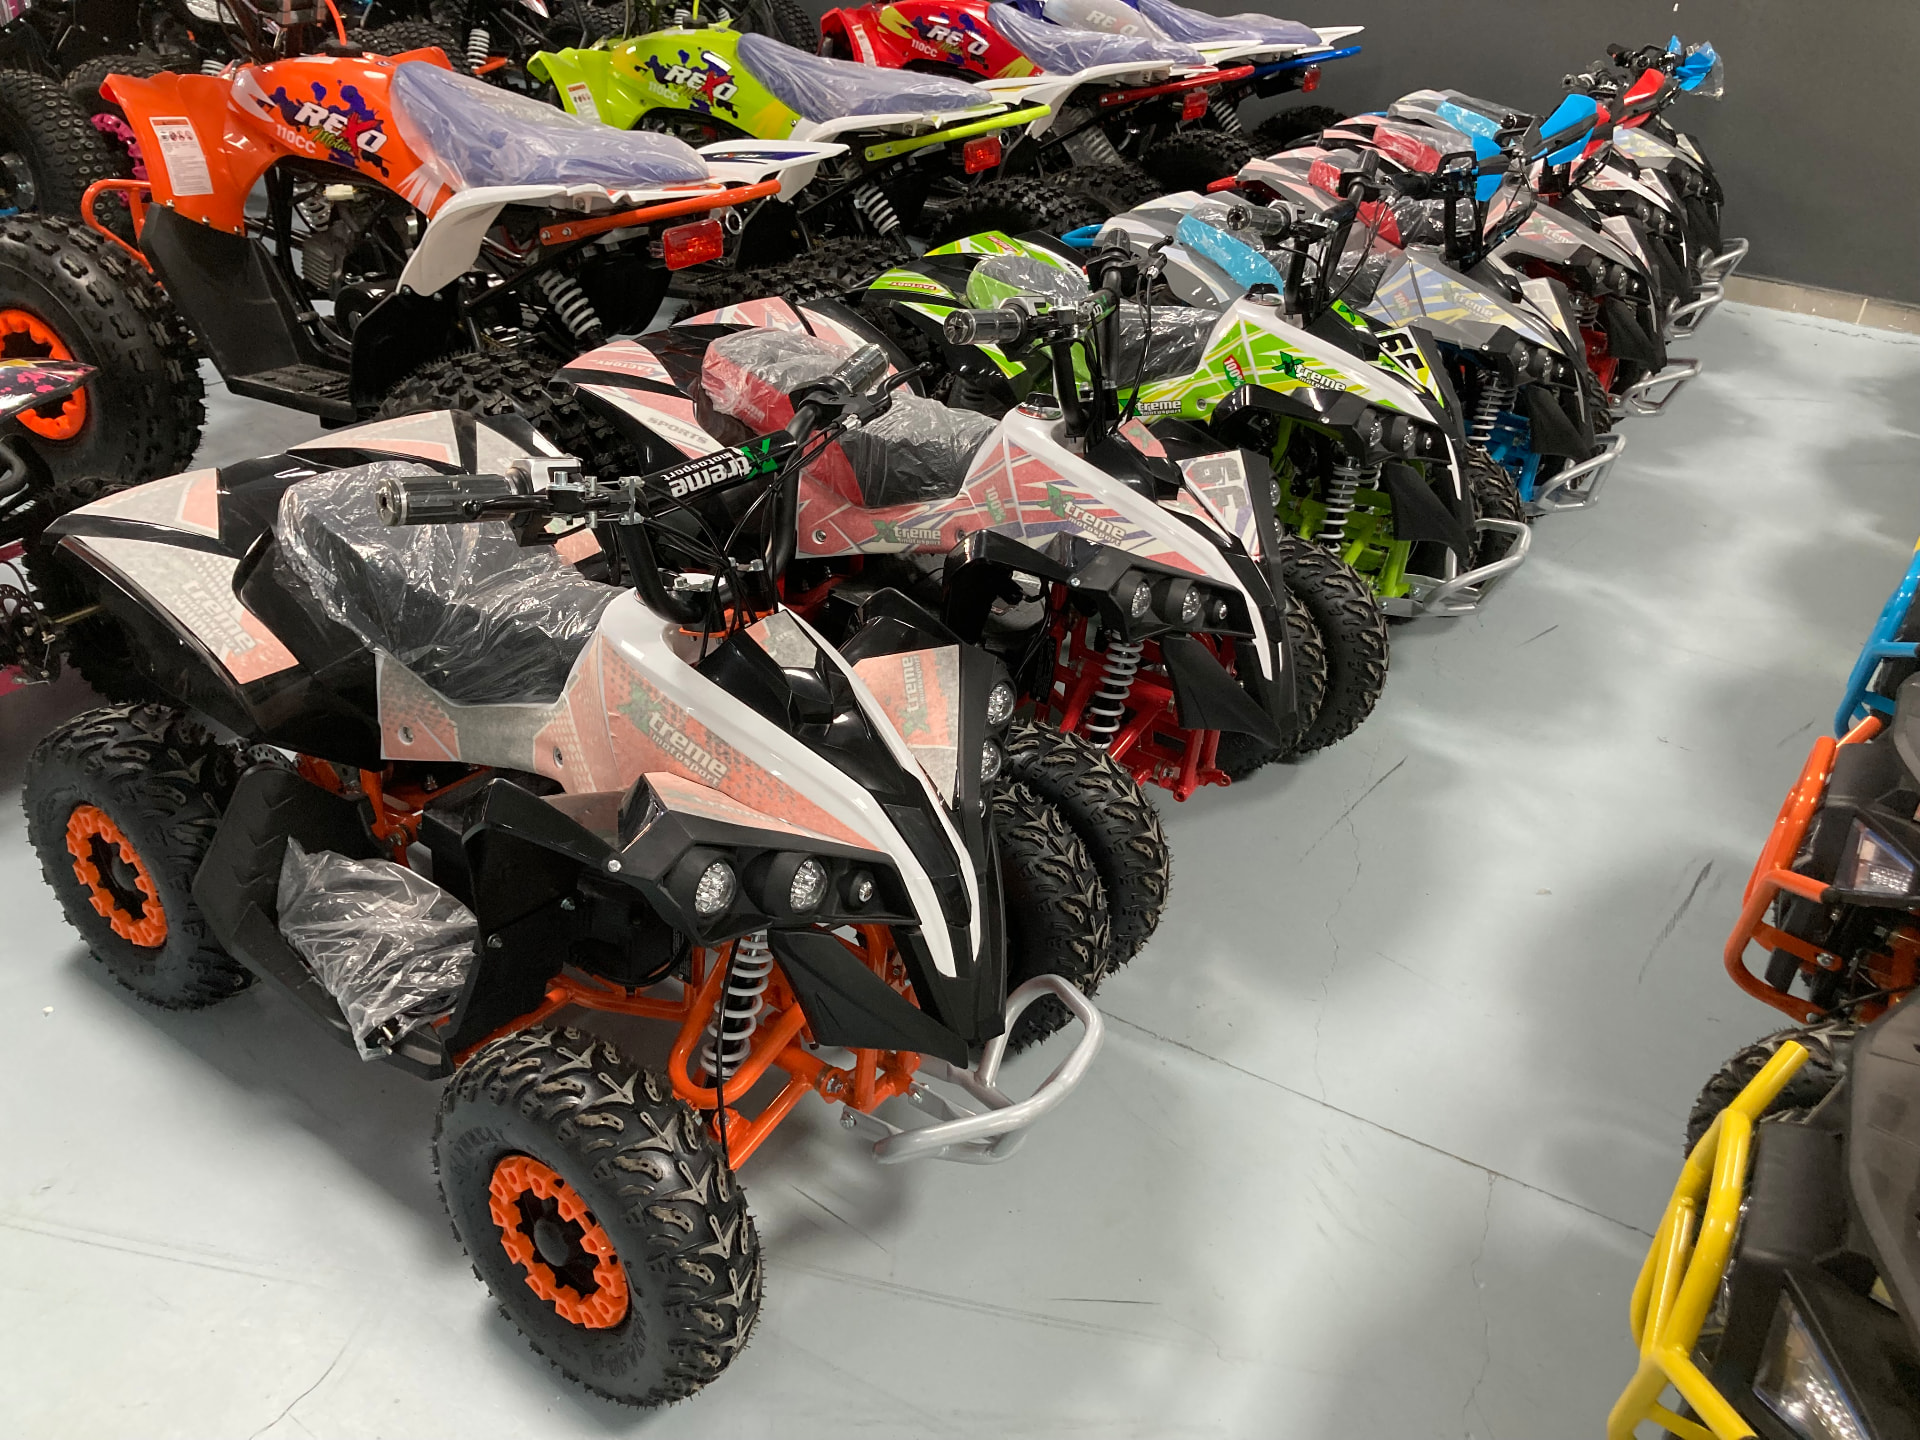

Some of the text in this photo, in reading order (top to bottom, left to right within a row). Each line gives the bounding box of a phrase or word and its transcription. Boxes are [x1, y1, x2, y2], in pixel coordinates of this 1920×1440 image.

[911, 39, 938, 58] 110CC
[664, 65, 738, 106] REXO
[276, 124, 317, 154] 110CC
[294, 101, 388, 162] REXO
[1222, 357, 1244, 387] 100%
[646, 416, 709, 445] SPORTS
[660, 451, 734, 481] motosport
[985, 485, 1006, 522] 100%
[1037, 482, 1126, 540] Xtreme
[872, 520, 941, 543] Xtreme
[1067, 517, 1122, 547] motosport
[616, 682, 728, 779] Xtreme
[651, 733, 721, 788] motosport
